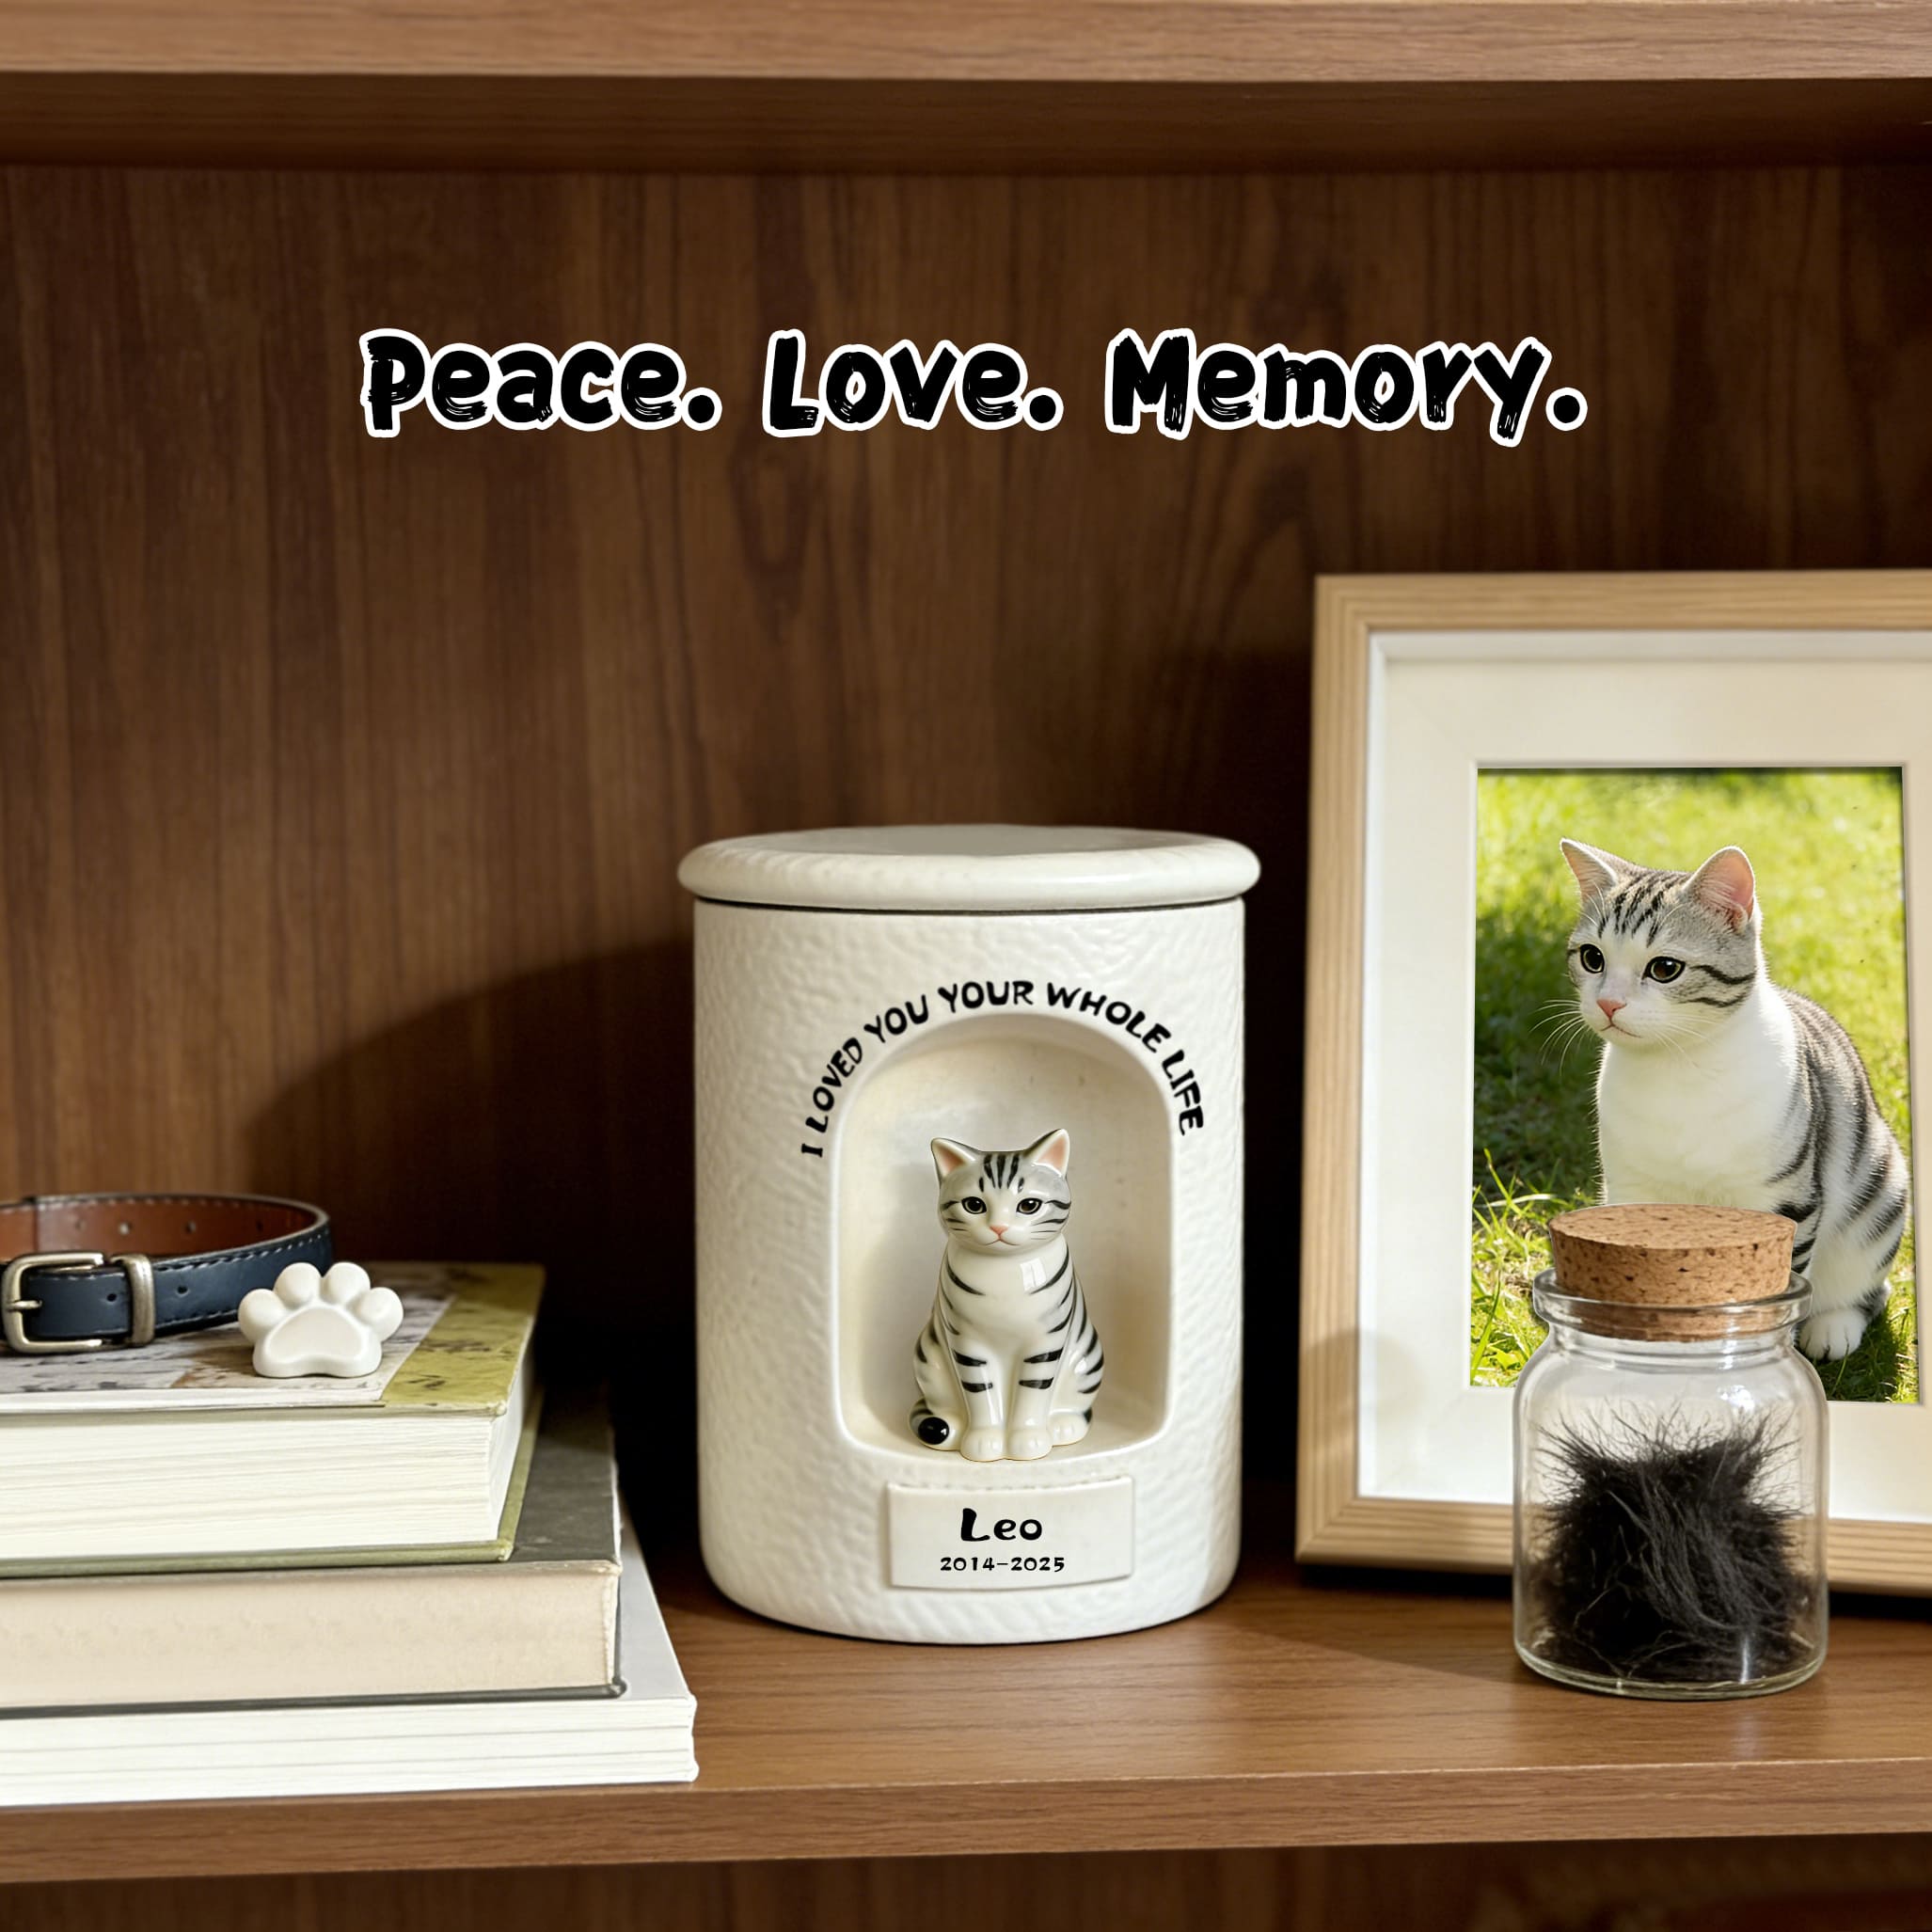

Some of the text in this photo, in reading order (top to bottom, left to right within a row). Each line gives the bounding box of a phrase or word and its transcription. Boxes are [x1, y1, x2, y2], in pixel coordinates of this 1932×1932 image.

[800, 980, 1204, 1158] I LOVED YOU YOUR WHOLE LIFE
[959, 1507, 1043, 1543] Leo
[940, 1557, 1066, 1573] 2014-2025
